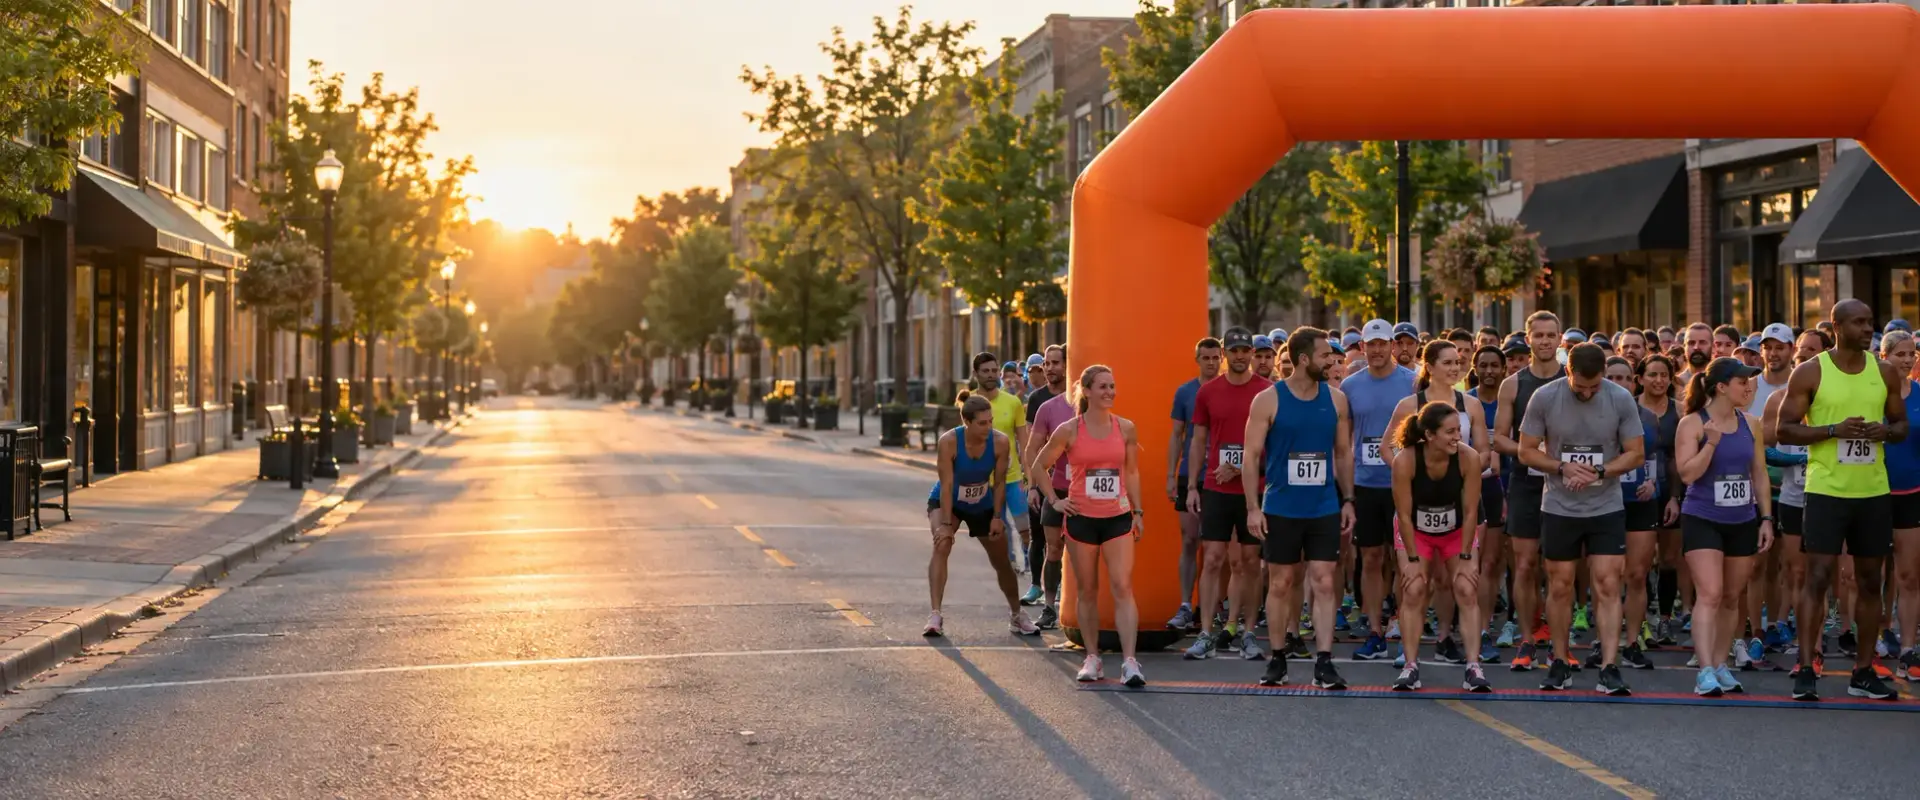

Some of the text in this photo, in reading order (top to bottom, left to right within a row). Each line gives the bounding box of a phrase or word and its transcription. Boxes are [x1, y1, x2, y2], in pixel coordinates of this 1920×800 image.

[1846, 440, 1870, 457] 736
[1297, 461, 1320, 478] 617
[1092, 477, 1115, 492] 482
[1723, 482, 1746, 499] 268
[1424, 513, 1449, 528] 394
